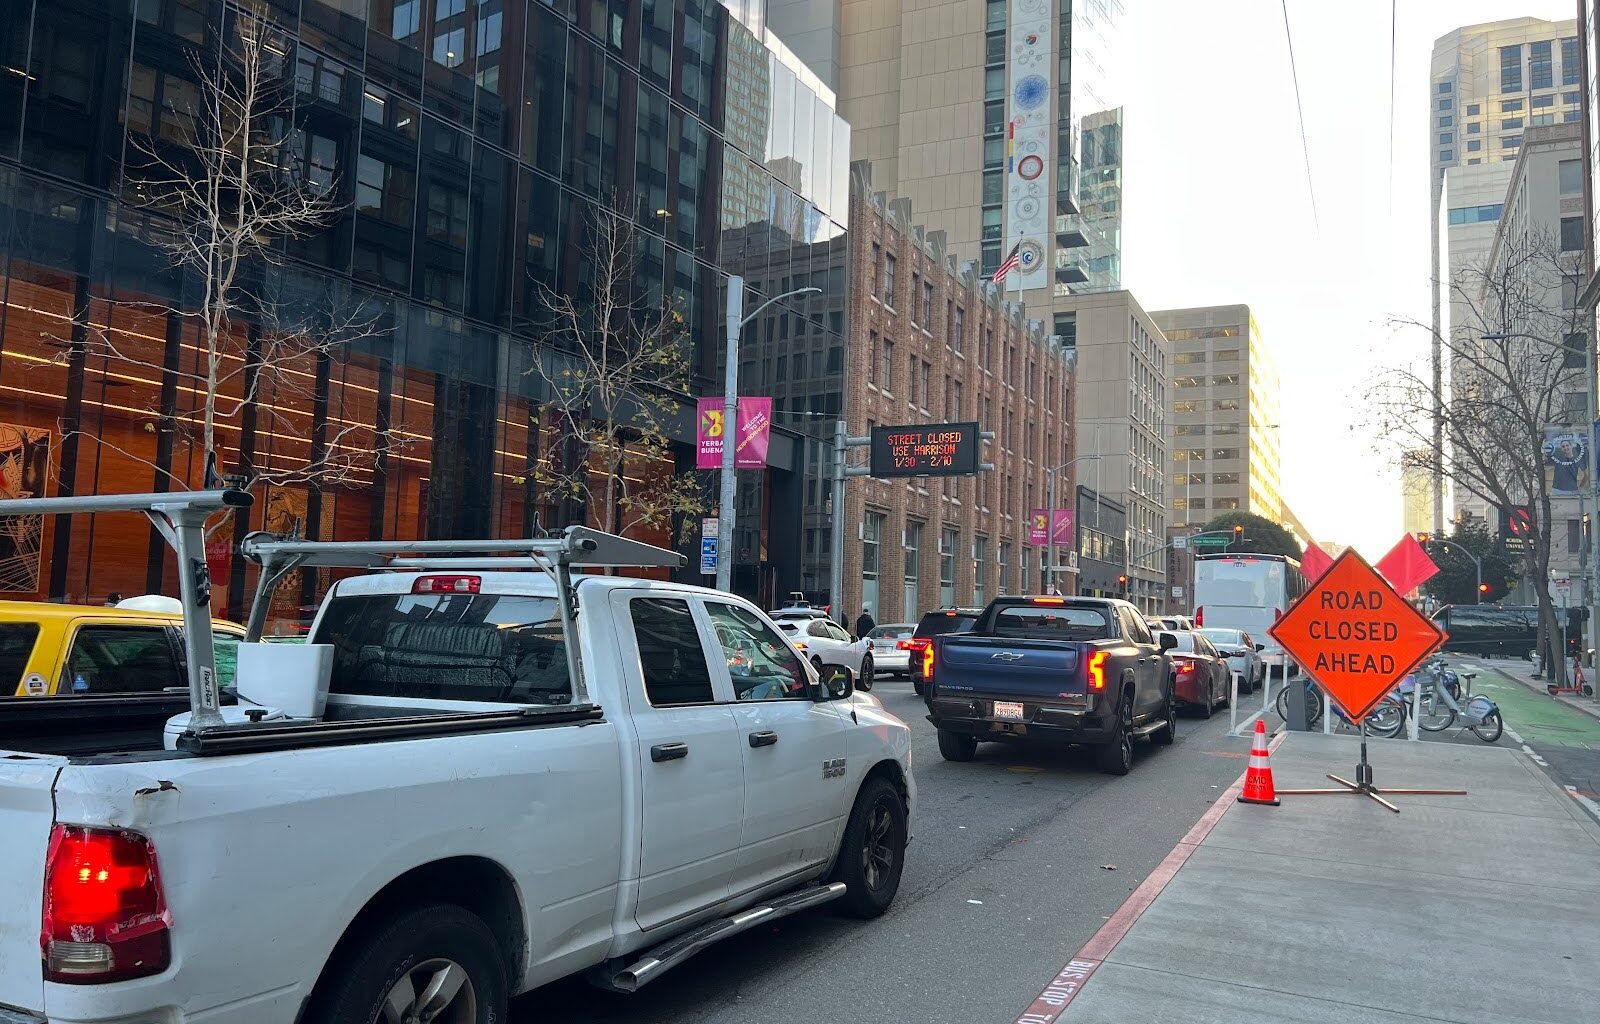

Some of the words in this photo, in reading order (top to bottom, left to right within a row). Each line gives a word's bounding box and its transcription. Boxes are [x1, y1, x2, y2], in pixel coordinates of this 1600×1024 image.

[741, 410, 763, 432] WELCOME
[887, 433, 922, 446] STREET
[927, 432, 962, 444] CLOSED
[892, 445, 909, 457] USE
[914, 444, 956, 456] HARRISON
[895, 457, 916, 468] 1/30
[930, 455, 952, 467] 2/10
[1321, 590, 1383, 610] ROAD
[1309, 620, 1398, 642] CLOSED
[1315, 652, 1395, 675] AHEAD
[1060, 960, 1095, 979] BUS
[1039, 980, 1078, 1005] STOP
